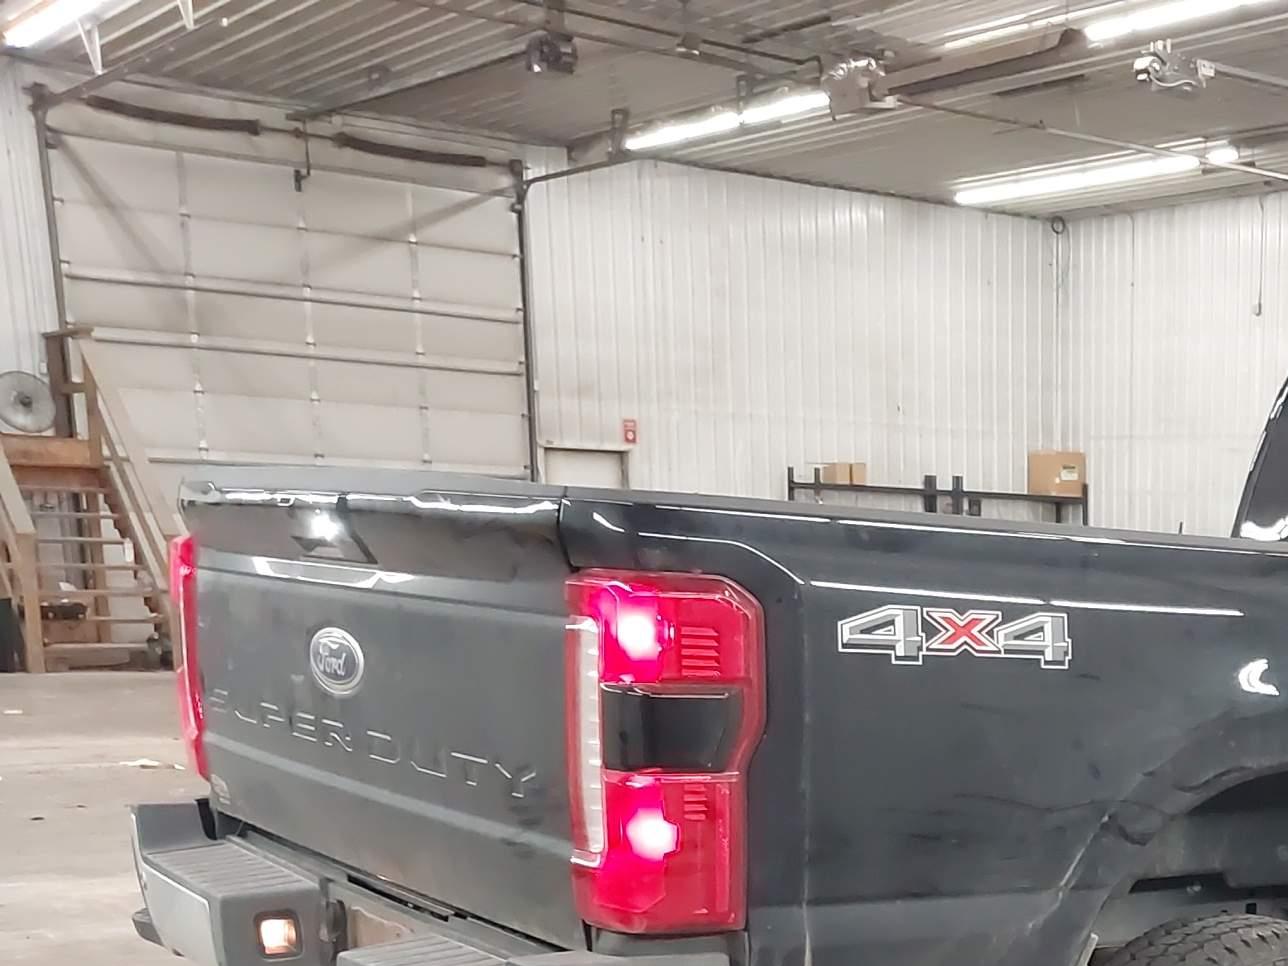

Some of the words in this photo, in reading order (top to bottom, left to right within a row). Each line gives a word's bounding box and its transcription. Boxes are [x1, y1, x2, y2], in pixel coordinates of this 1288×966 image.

[317, 640, 347, 677] Ford
[207, 687, 353, 752] SUPER
[365, 730, 537, 798] DUTY
